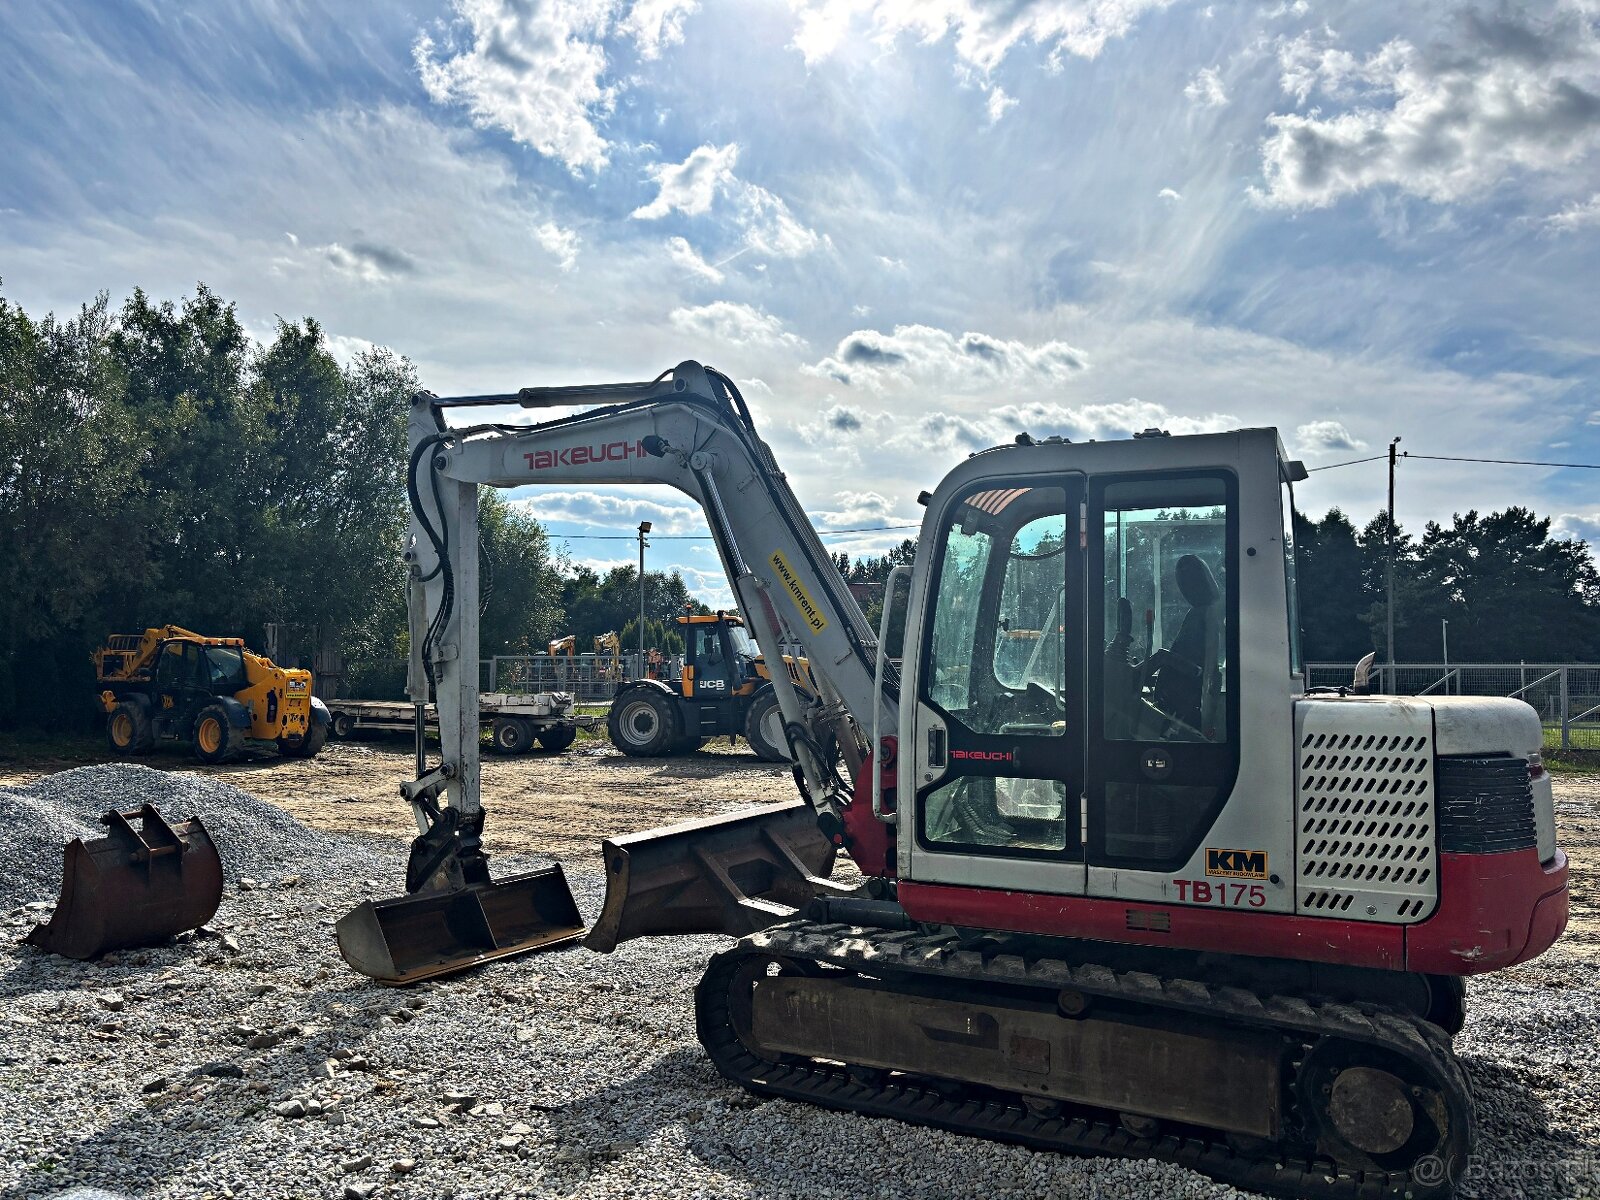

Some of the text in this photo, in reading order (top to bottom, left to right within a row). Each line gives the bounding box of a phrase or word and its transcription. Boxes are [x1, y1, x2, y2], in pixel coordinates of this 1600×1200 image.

[773, 554, 824, 630] www.kmrent.pl
[699, 680, 725, 689] JCB
[950, 750, 1012, 761] TAKEUCHI
[1208, 850, 1265, 873] KM
[1173, 879, 1266, 908] TB175
